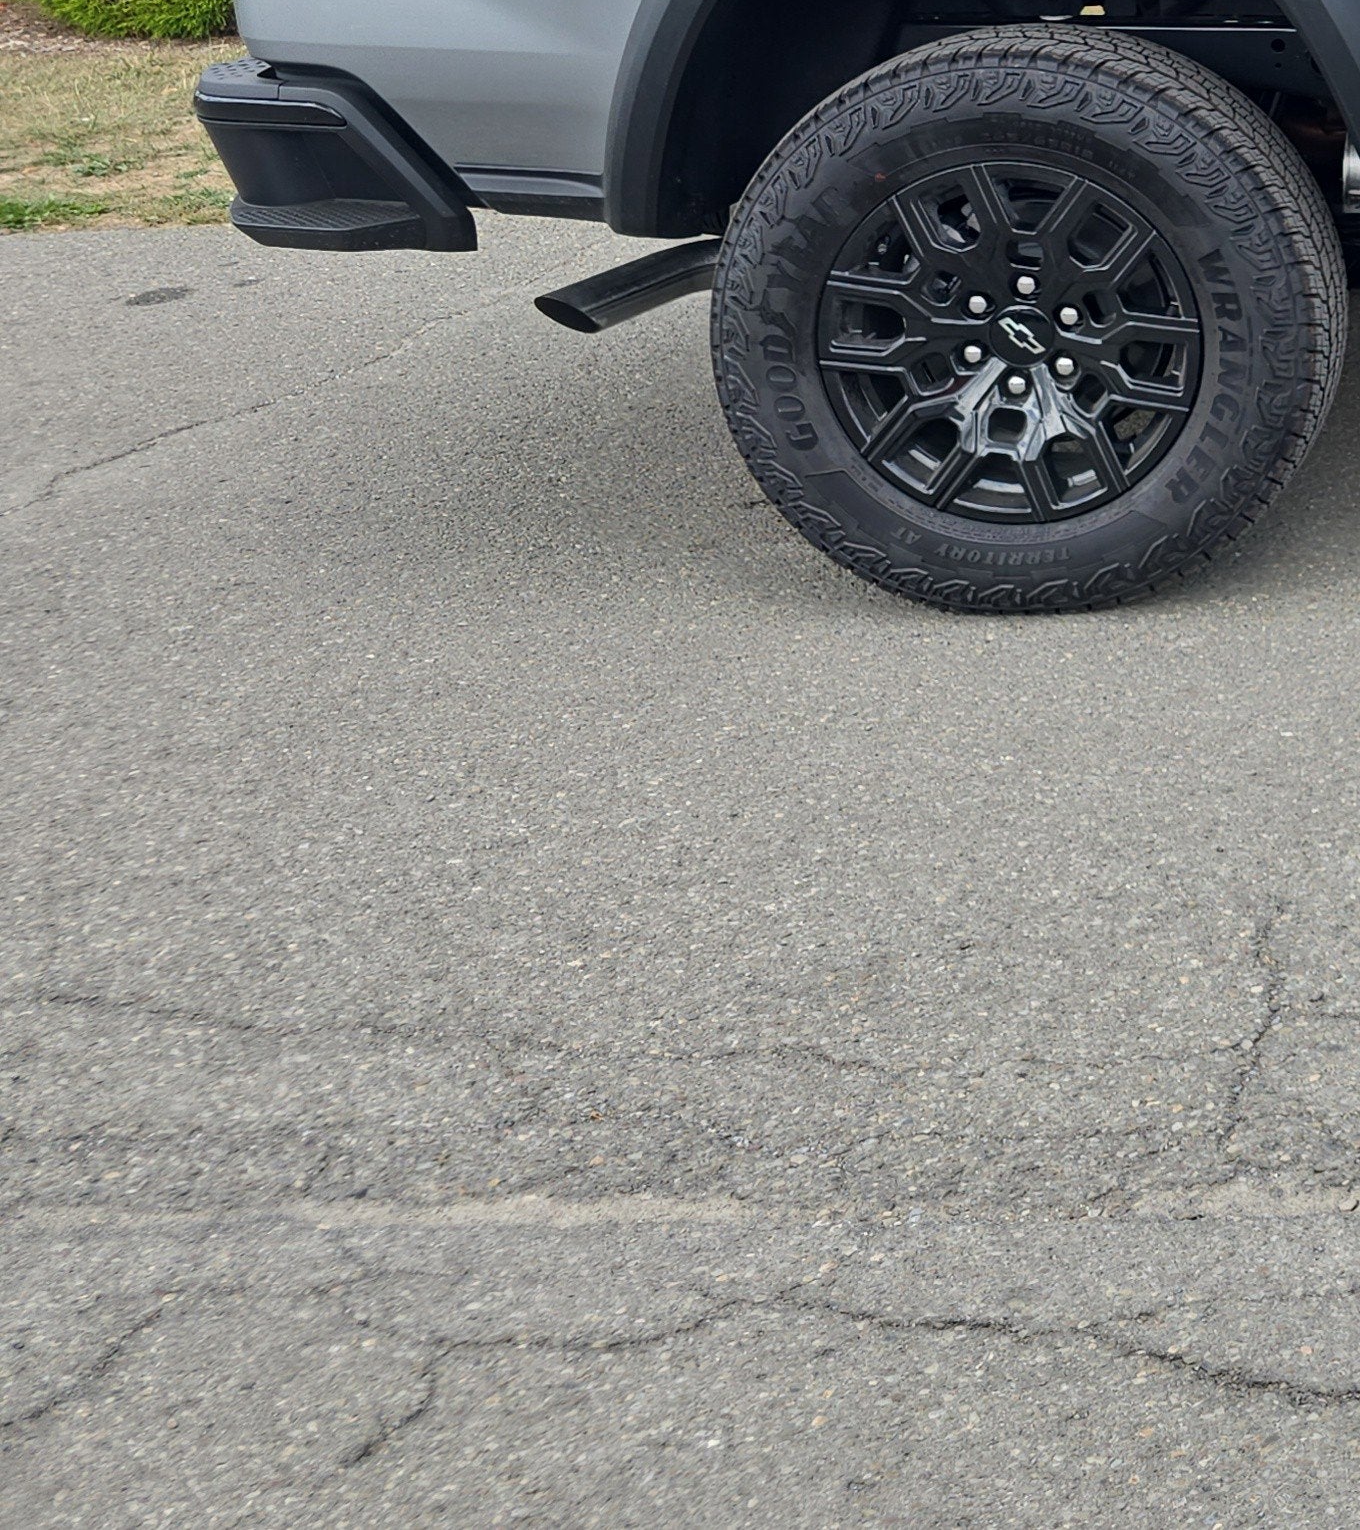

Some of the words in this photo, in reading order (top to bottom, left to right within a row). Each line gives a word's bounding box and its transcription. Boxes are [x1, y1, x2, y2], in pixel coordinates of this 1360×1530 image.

[760, 186, 855, 452] GOODYEAR
[1163, 248, 1244, 505] WRANGLER
[931, 540, 1071, 567] TERRITORY
